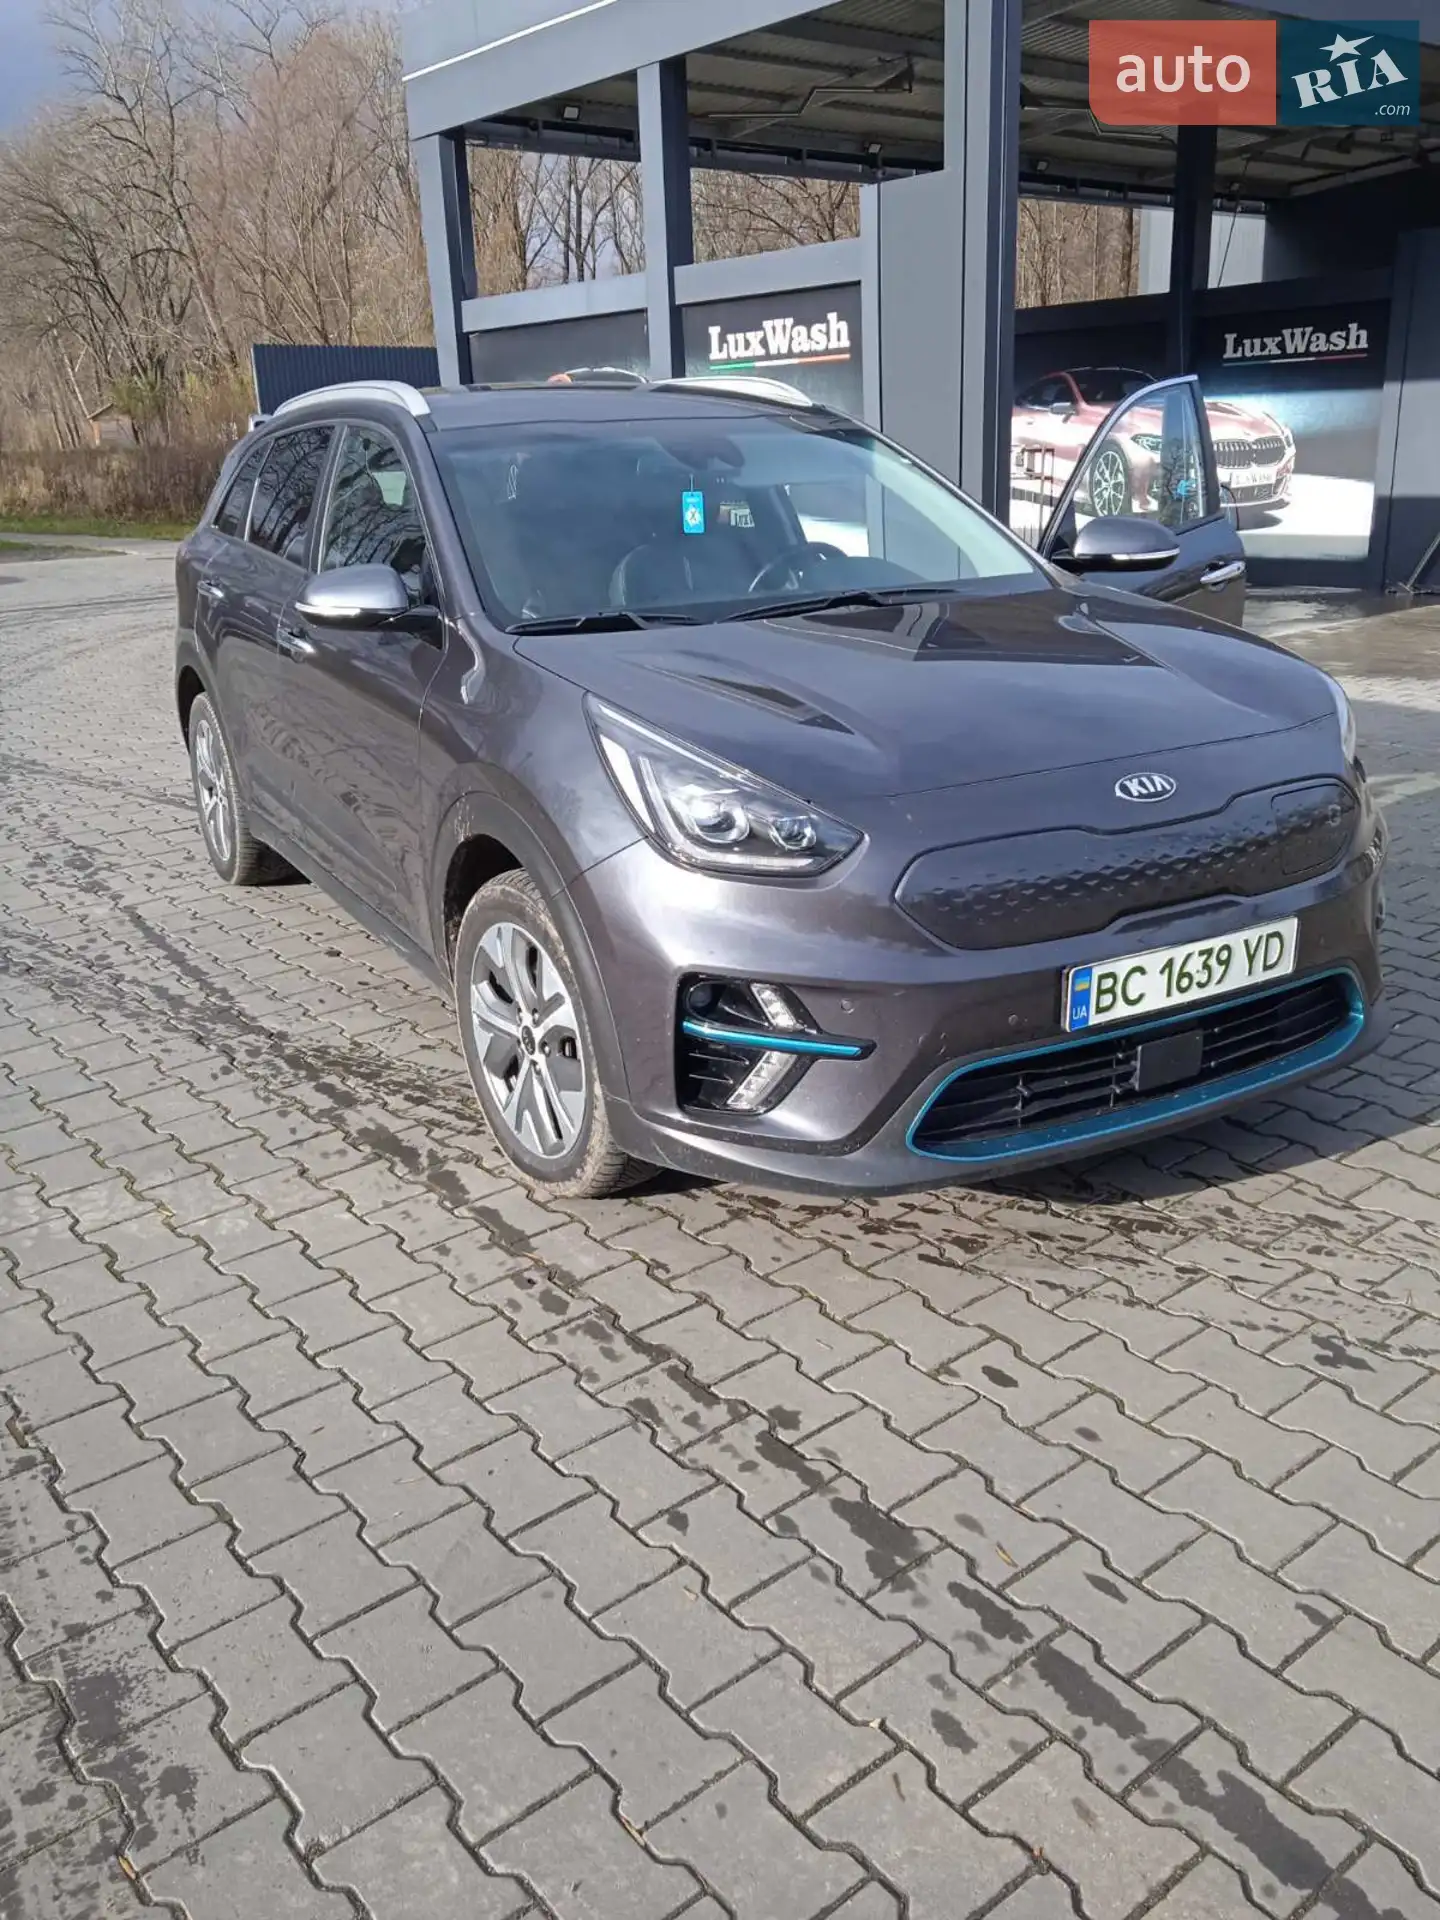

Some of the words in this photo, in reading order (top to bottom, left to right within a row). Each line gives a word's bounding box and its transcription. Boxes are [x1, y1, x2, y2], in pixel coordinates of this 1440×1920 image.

[708, 312, 850, 360] LuxWash
[1223, 323, 1368, 359] LuxWash
[1122, 775, 1171, 796] KIA
[1094, 965, 1147, 1015] BC
[1160, 944, 1232, 998] 1639
[1243, 930, 1284, 976] YD
[1072, 1005, 1087, 1020] UA
